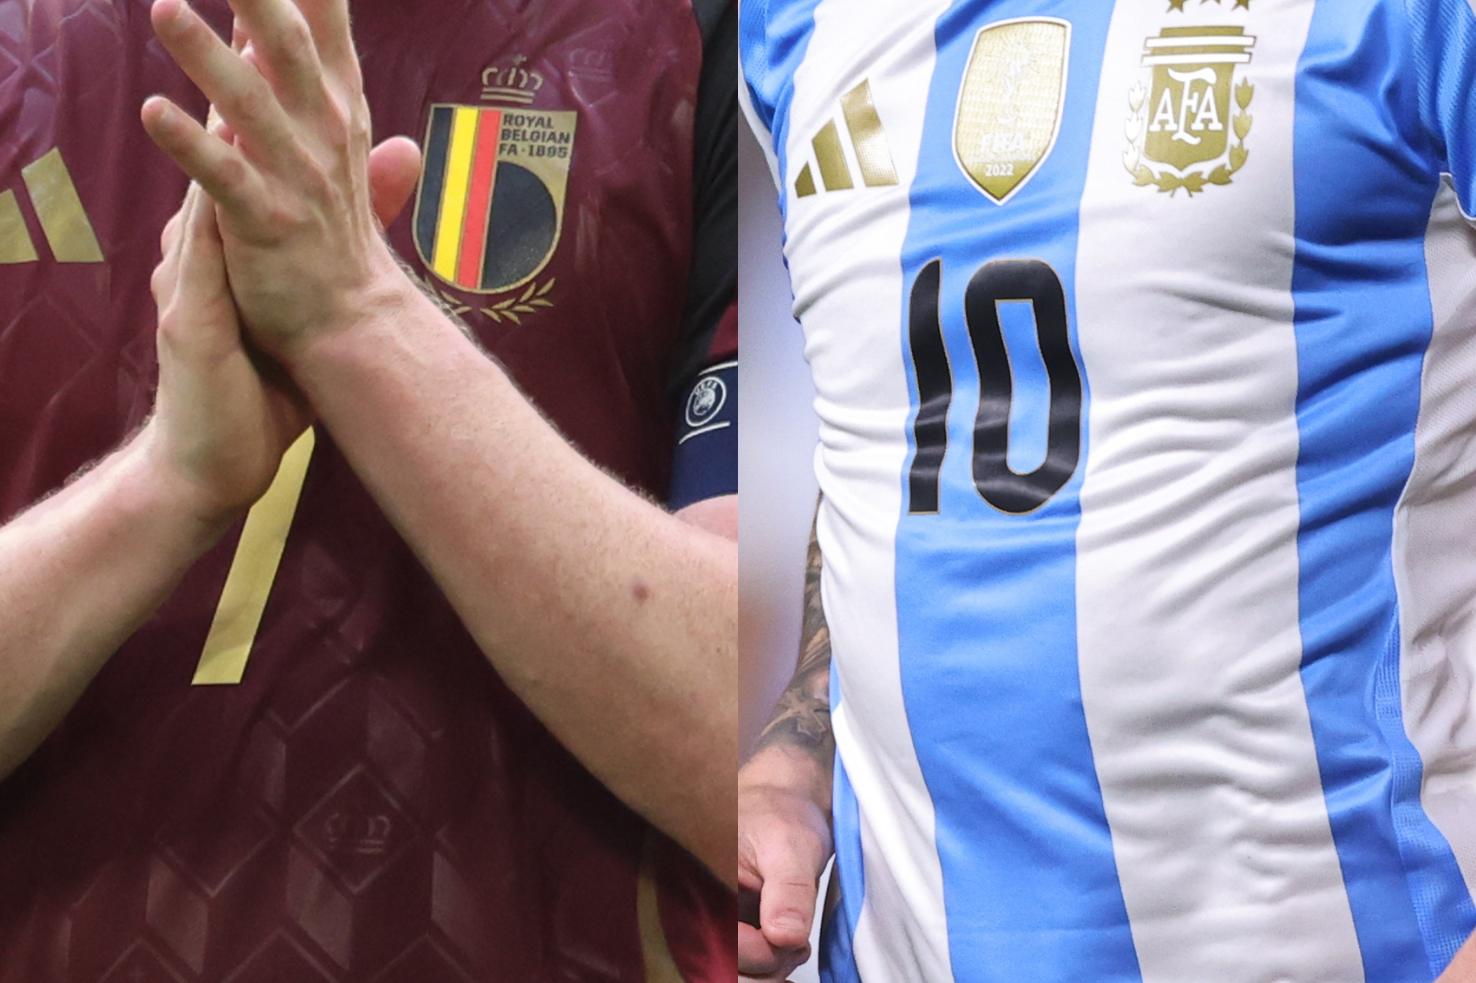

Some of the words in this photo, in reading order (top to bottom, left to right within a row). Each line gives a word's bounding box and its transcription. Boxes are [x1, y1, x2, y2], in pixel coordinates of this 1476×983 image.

[1148, 66, 1223, 146] AFA
[503, 113, 554, 129] ROYAL
[501, 128, 571, 145] BELGIAN
[980, 132, 1025, 154] FIFA
[498, 143, 518, 156] FA
[985, 163, 1014, 177] 2022
[908, 257, 1083, 516] 10
